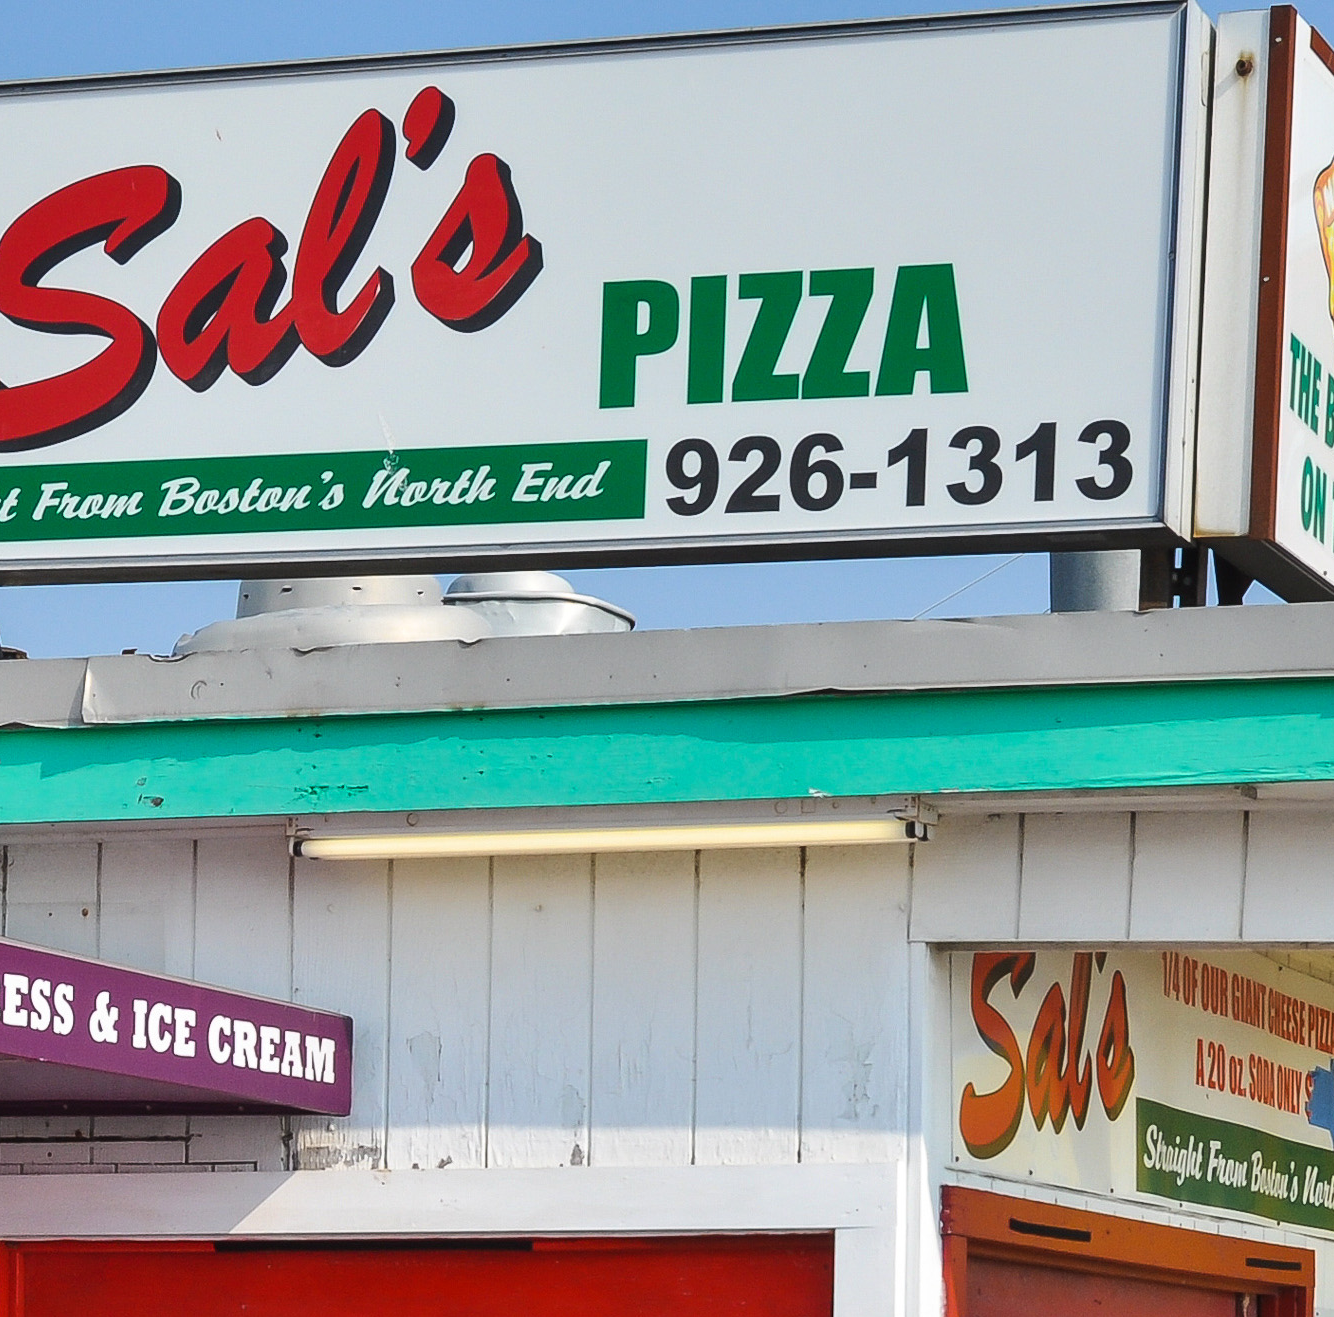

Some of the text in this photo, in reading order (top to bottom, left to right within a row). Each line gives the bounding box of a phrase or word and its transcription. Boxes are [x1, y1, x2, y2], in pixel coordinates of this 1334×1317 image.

[599, 263, 969, 409] PIZZA
[1290, 332, 1319, 433] THE
[31, 483, 143, 521] From
[159, 471, 345, 518] Boston's
[362, 463, 496, 508] North
[515, 462, 611, 500] End
[666, 419, 1134, 516] 926-1313
[1301, 456, 1327, 546] ON
[89, 991, 118, 1043] &
[133, 1000, 197, 1057] ICE
[208, 1014, 337, 1084] CREAM
[1183, 956, 1198, 1007] OF
[1201, 963, 1228, 1017] OUR
[1232, 974, 1266, 1029] GIANT
[1268, 988, 1305, 1046] CHEESE
[1196, 1038, 1204, 1087] A
[1208, 1041, 1226, 1092] 20
[1249, 1053, 1275, 1108] SODA
[1277, 1065, 1302, 1115] ONLY
[1144, 1124, 1204, 1186] Straight
[1208, 1140, 1247, 1188] From
[1251, 1150, 1299, 1203] Boston's
